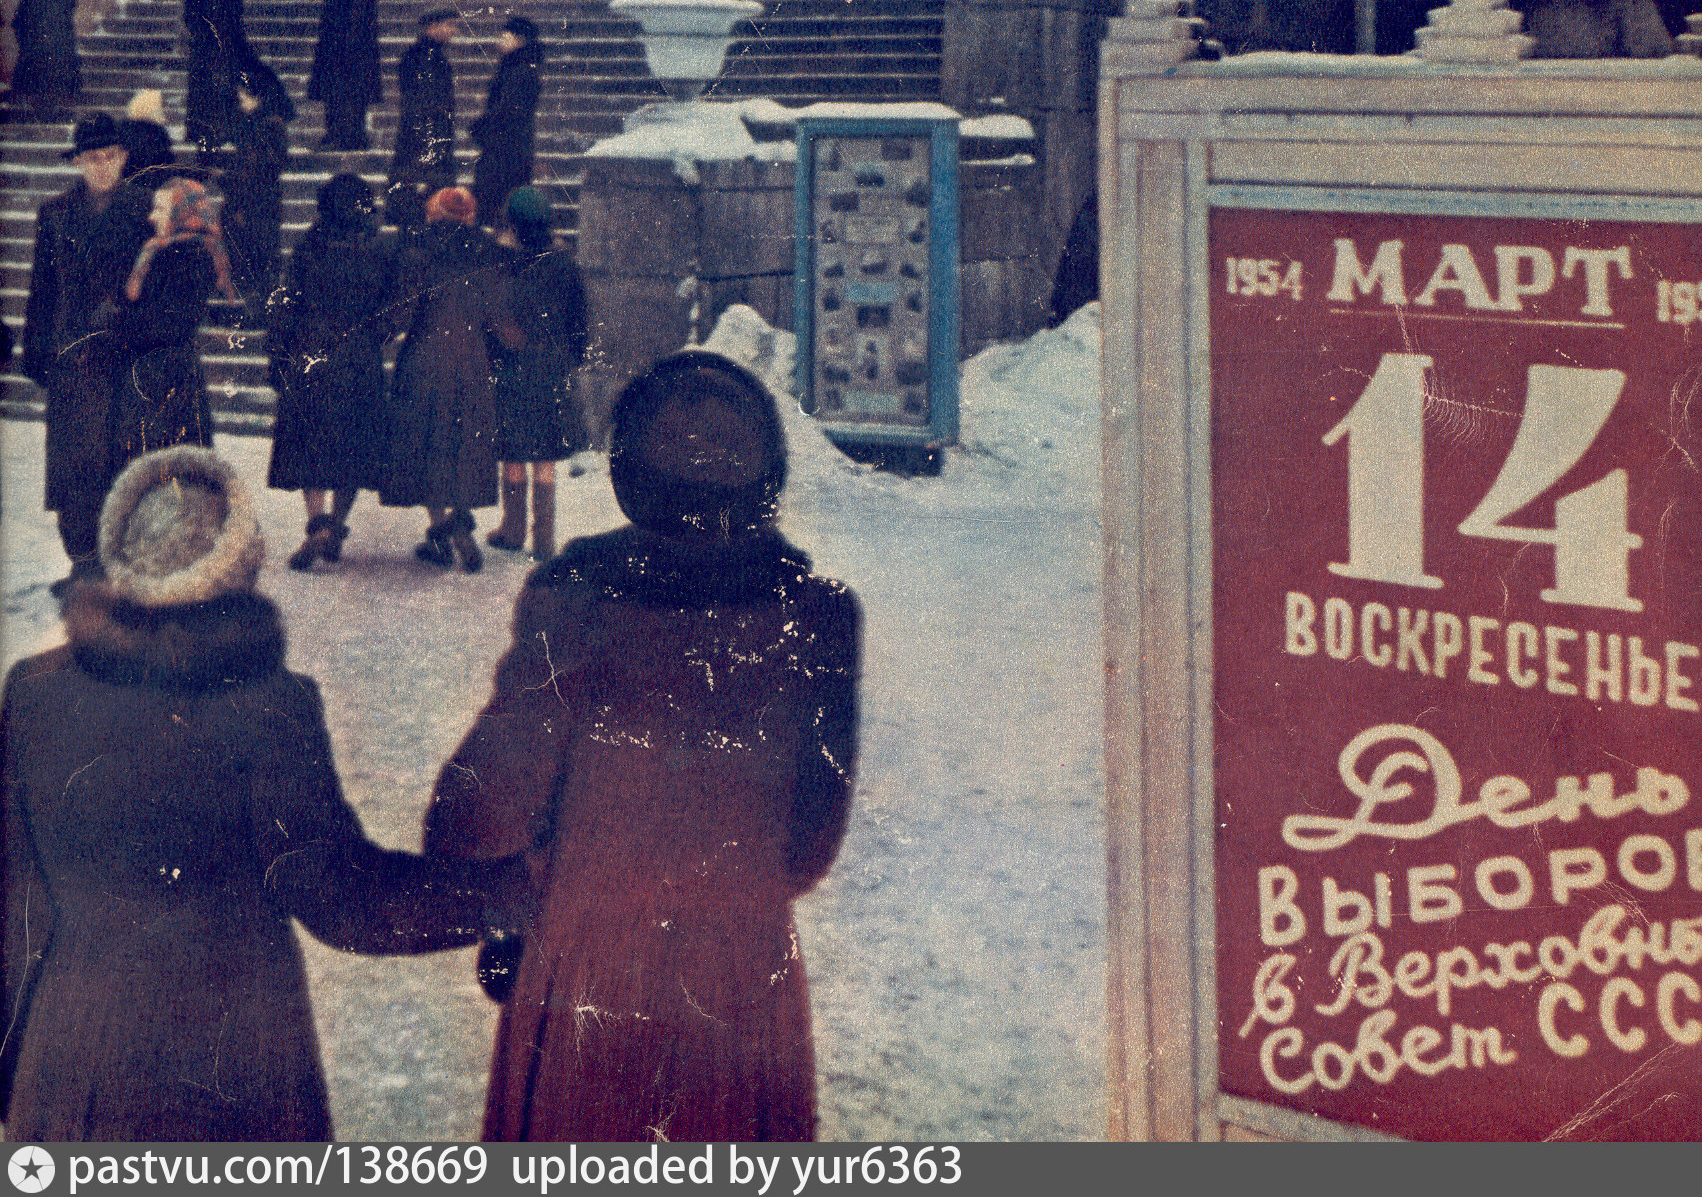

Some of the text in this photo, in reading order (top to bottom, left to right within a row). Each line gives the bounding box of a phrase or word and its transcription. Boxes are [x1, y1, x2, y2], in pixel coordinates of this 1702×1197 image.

[1226, 238, 1702, 325] 1954 МАРТ 19
[1322, 352, 1644, 612] 14
[1285, 590, 1701, 713] ВОСКРЕСЕНЬЕ
[1282, 723, 1691, 851] День
